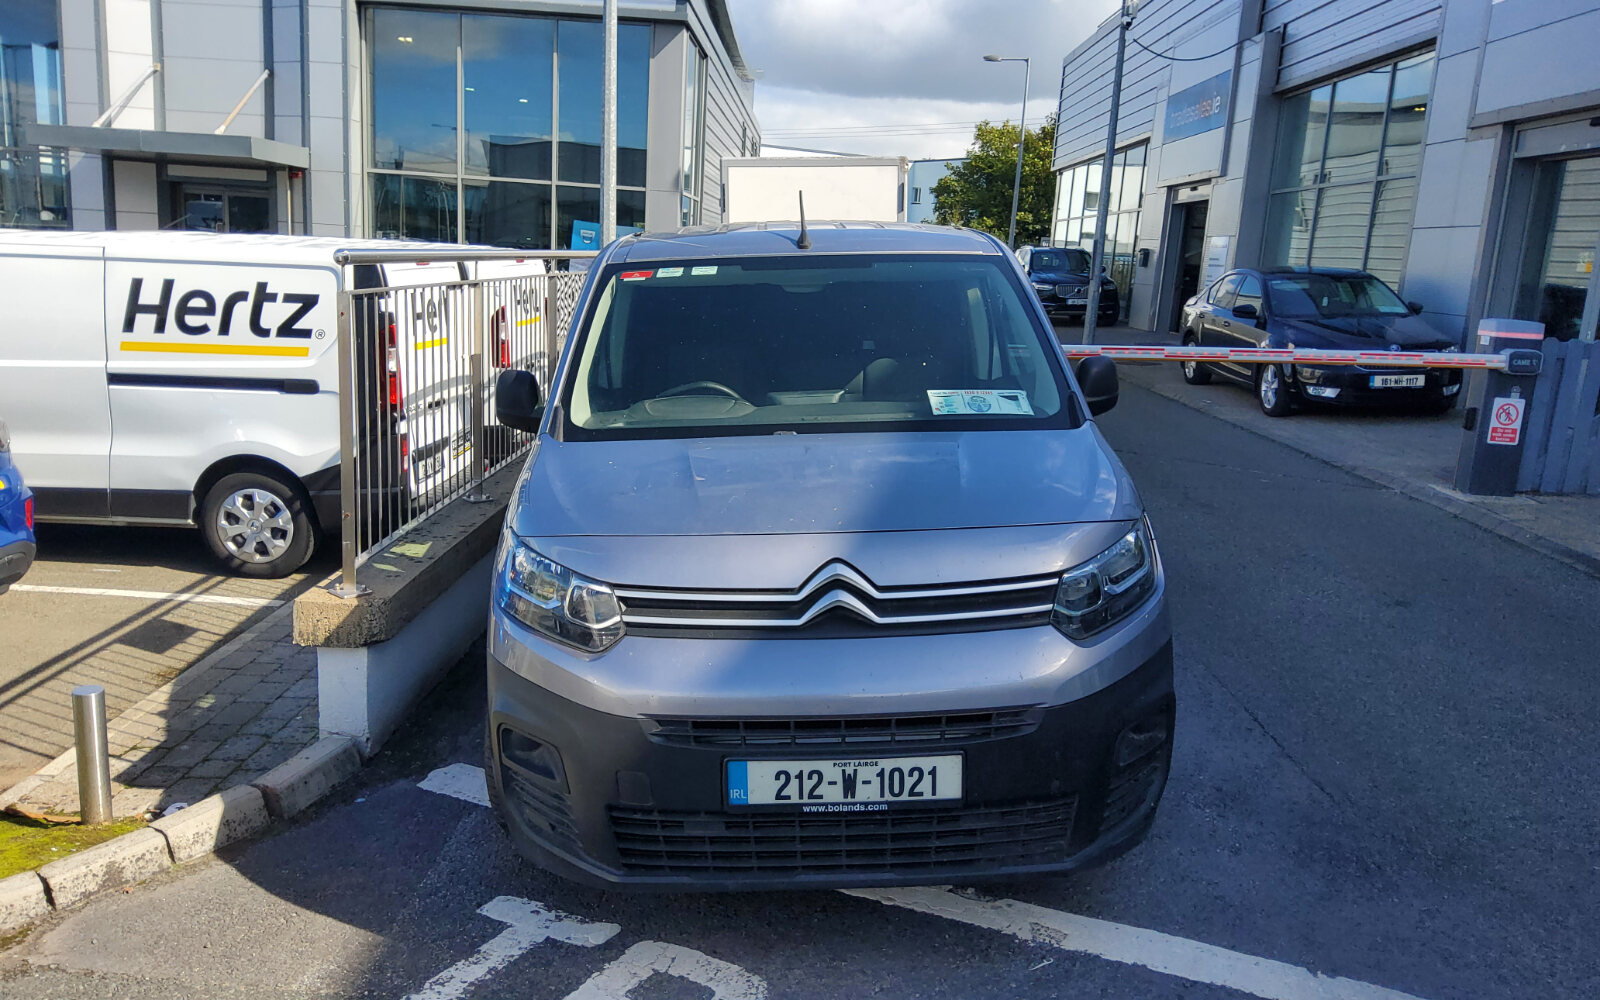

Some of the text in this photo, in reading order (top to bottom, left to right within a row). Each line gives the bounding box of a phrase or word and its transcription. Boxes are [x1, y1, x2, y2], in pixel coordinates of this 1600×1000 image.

[122, 277, 320, 339] Hertz
[730, 789, 747, 799] IRL
[774, 765, 938, 801] 212-W-1021
[802, 802, 889, 813] www.bolands.com
